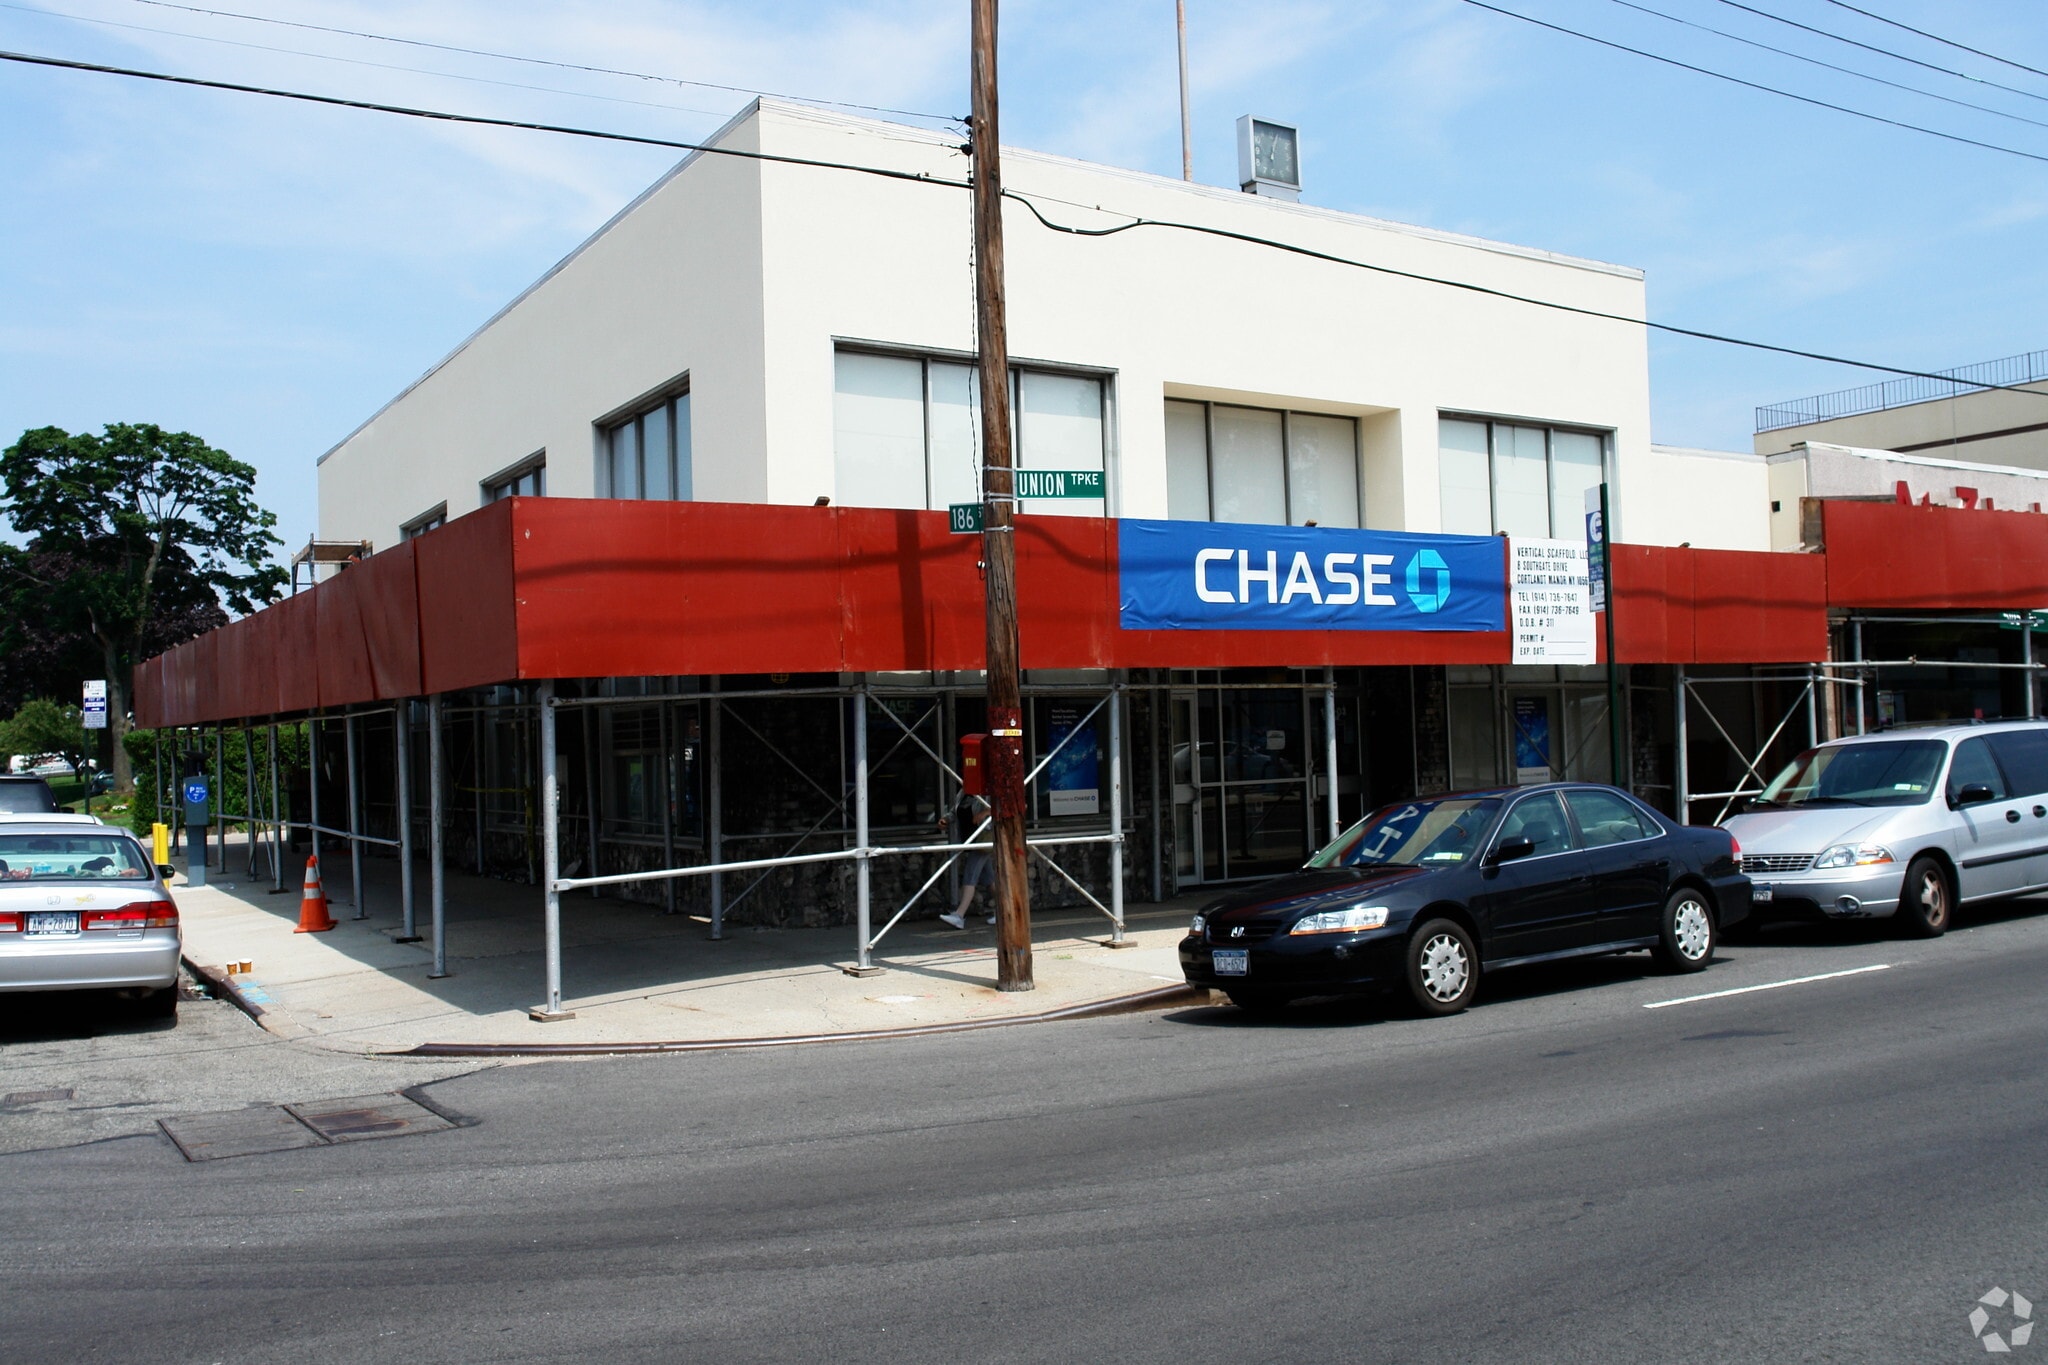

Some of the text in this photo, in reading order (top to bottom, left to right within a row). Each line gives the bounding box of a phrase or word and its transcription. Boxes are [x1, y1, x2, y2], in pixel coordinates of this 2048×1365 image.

[1019, 472, 1099, 496] UNION TPKE
[952, 507, 974, 530] 186
[1517, 547, 1545, 558] VERTICAL
[1522, 560, 1551, 571] SOUTHGATE
[1553, 562, 1568, 572] DRIVE
[1194, 547, 1397, 606] CHASE
[1548, 575, 1566, 585] MANOR
[1568, 575, 1575, 585] NY
[1576, 575, 1589, 586] 1056
[1518, 592, 1529, 601] TEL
[1531, 592, 1547, 602] (914)
[1519, 605, 1531, 614] FAX
[1533, 605, 1549, 615] (914)
[1520, 634, 1539, 643] PERMIT
[1533, 647, 1545, 656] DATE
